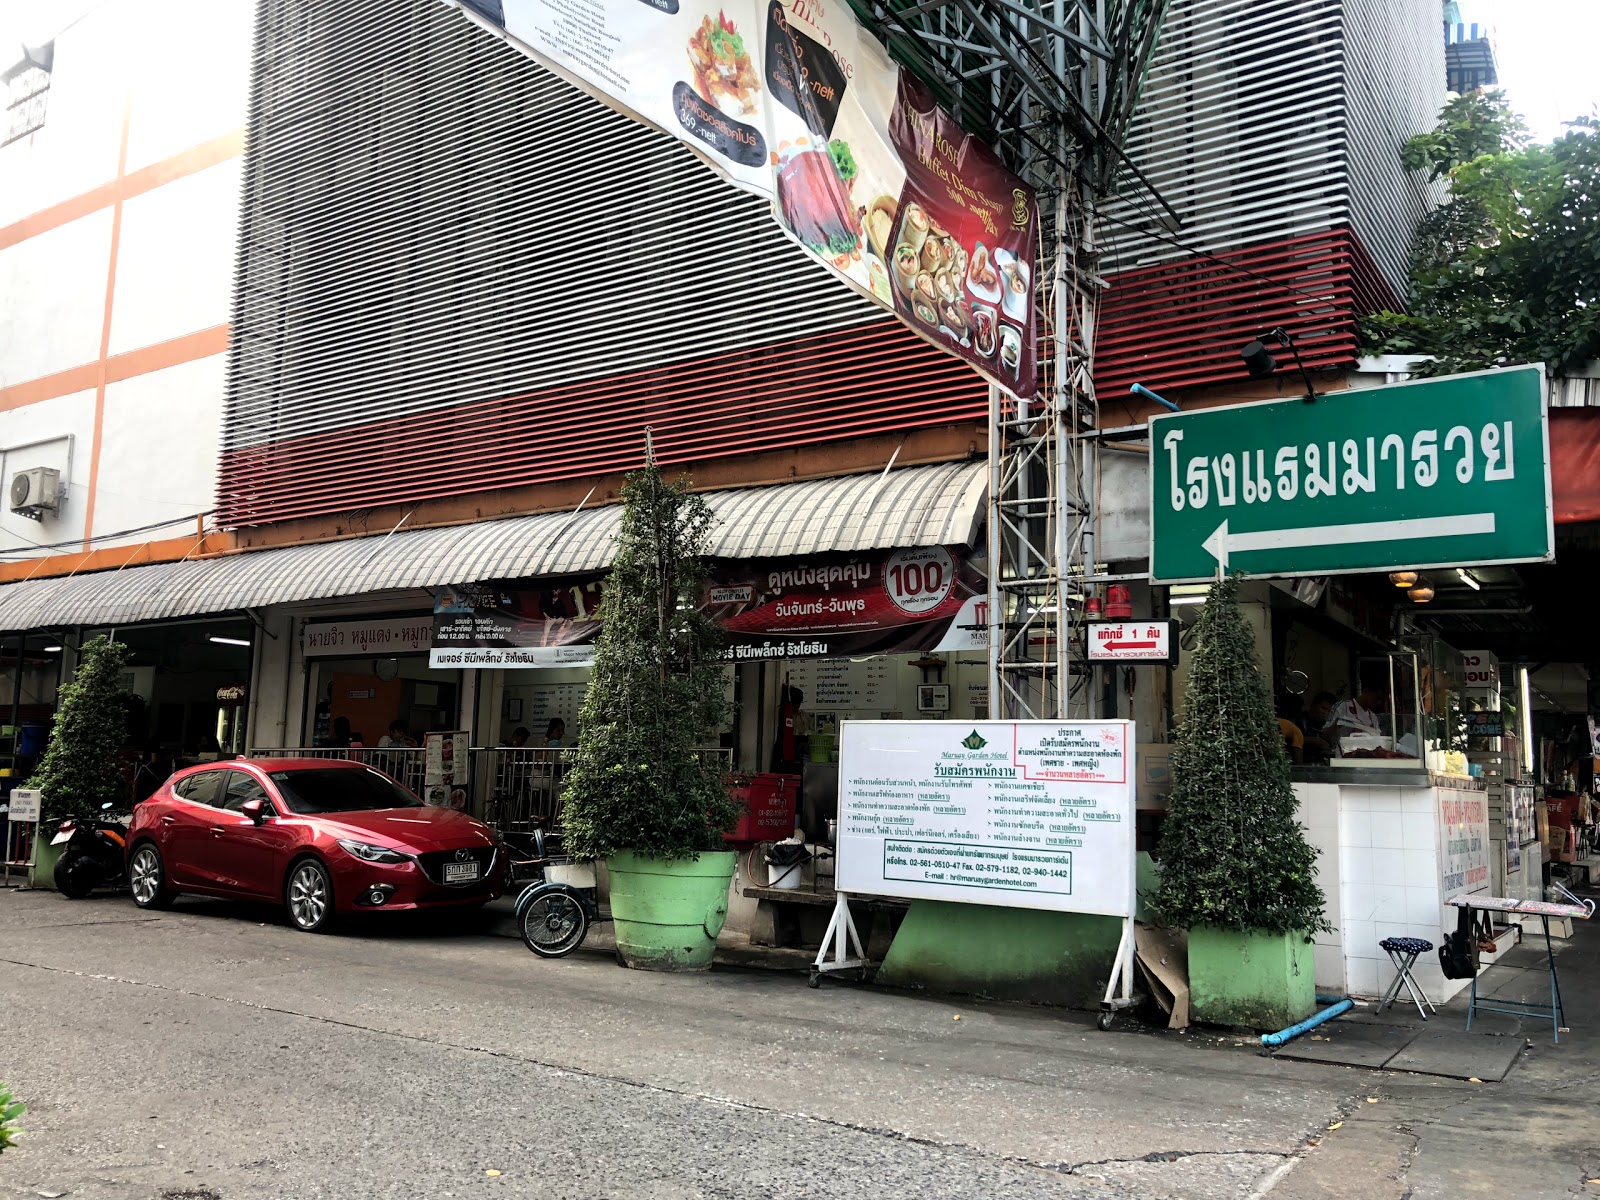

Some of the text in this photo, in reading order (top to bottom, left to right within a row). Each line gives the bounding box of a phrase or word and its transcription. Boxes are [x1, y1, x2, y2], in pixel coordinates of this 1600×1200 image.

[935, 134, 960, 168] ROSE
[917, 145, 1004, 216] Buffet Dim Sum
[1163, 421, 1515, 512] โรงแรมมารวย
[768, 562, 871, 595] ดูหนังสุดคุ้ม
[712, 592, 750, 602] MOVIE DAY
[775, 597, 865, 618] วันจันทร์-วันพุธ
[309, 626, 345, 647] นายจิว
[351, 628, 391, 651] หมูแดง
[1132, 628, 1137, 639] 1
[1146, 625, 1161, 639] คัน
[437, 649, 534, 663] เมเจอร์ ซีนีเพล็กซ์ รัชโยธิน
[736, 641, 785, 658] ซีนีเพล็กซ์
[787, 640, 828, 656] รัชโยธิน
[1467, 713, 1500, 723] PEN
[1057, 728, 1082, 737] ประกาศ
[1468, 724, 1502, 735] LCOME
[1040, 738, 1100, 748] เปิดรับสมัครพนักงาน
[941, 751, 1008, 760] Maruay Garden Hotel
[1018, 747, 1122, 758] ตำแหน่งพนักงานทำความสะอาดห้องพัก
[934, 762, 1016, 777] รับสมัครพนักงาน
[909, 859, 961, 870] 02-561-0510-47
[962, 863, 973, 871] Fax.
[975, 863, 1020, 875] 02-579-1182,
[1022, 867, 1068, 878] 02-940-1442
[925, 872, 944, 880] E-mail
[950, 874, 1038, 888] hr@maruaygardenhotel.com
